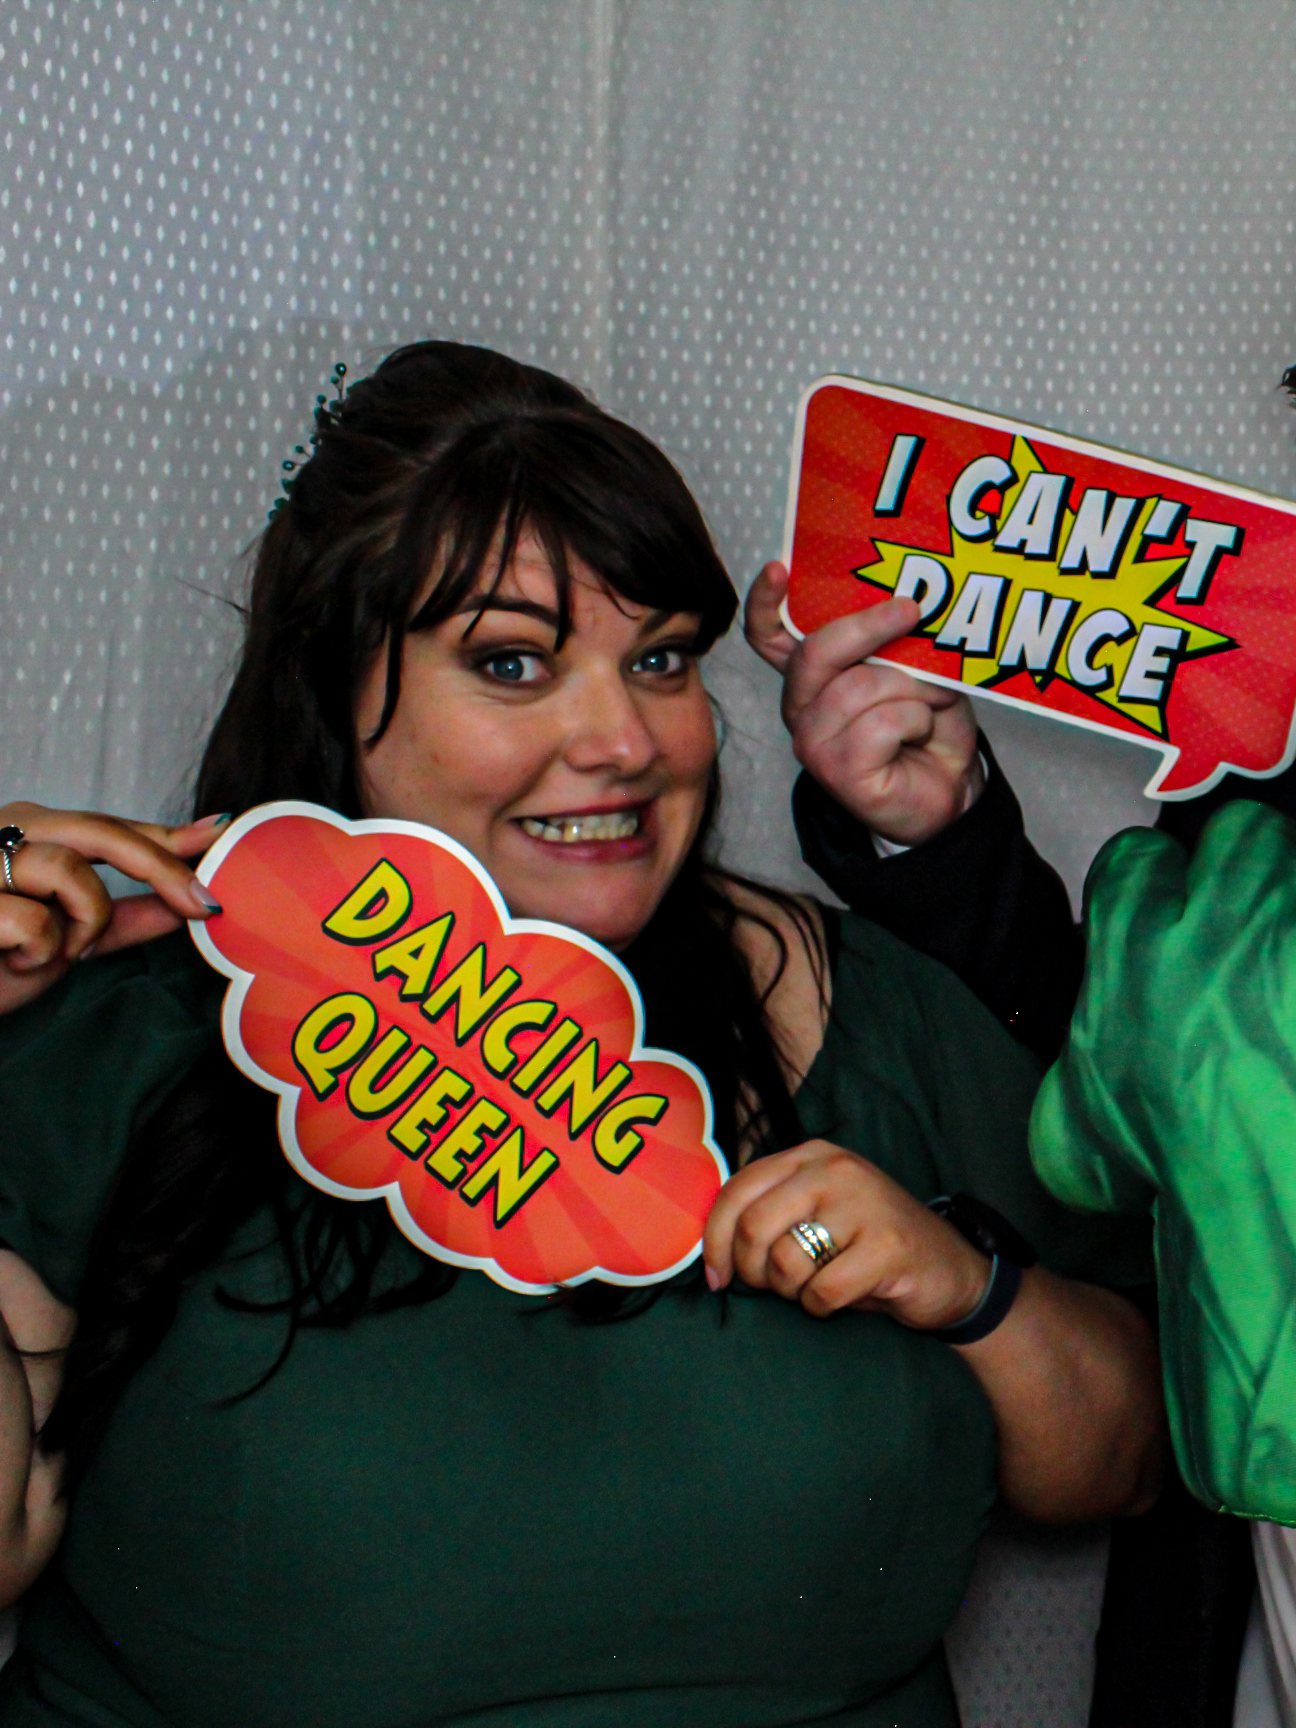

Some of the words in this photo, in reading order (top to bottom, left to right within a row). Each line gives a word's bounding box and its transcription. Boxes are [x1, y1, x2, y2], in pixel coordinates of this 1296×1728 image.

[874, 434, 925, 517] I
[947, 455, 1244, 605] CAN'T
[890, 554, 1188, 701] DANCE
[292, 992, 559, 1229] QUEEN
[321, 858, 669, 1173] DANCING
